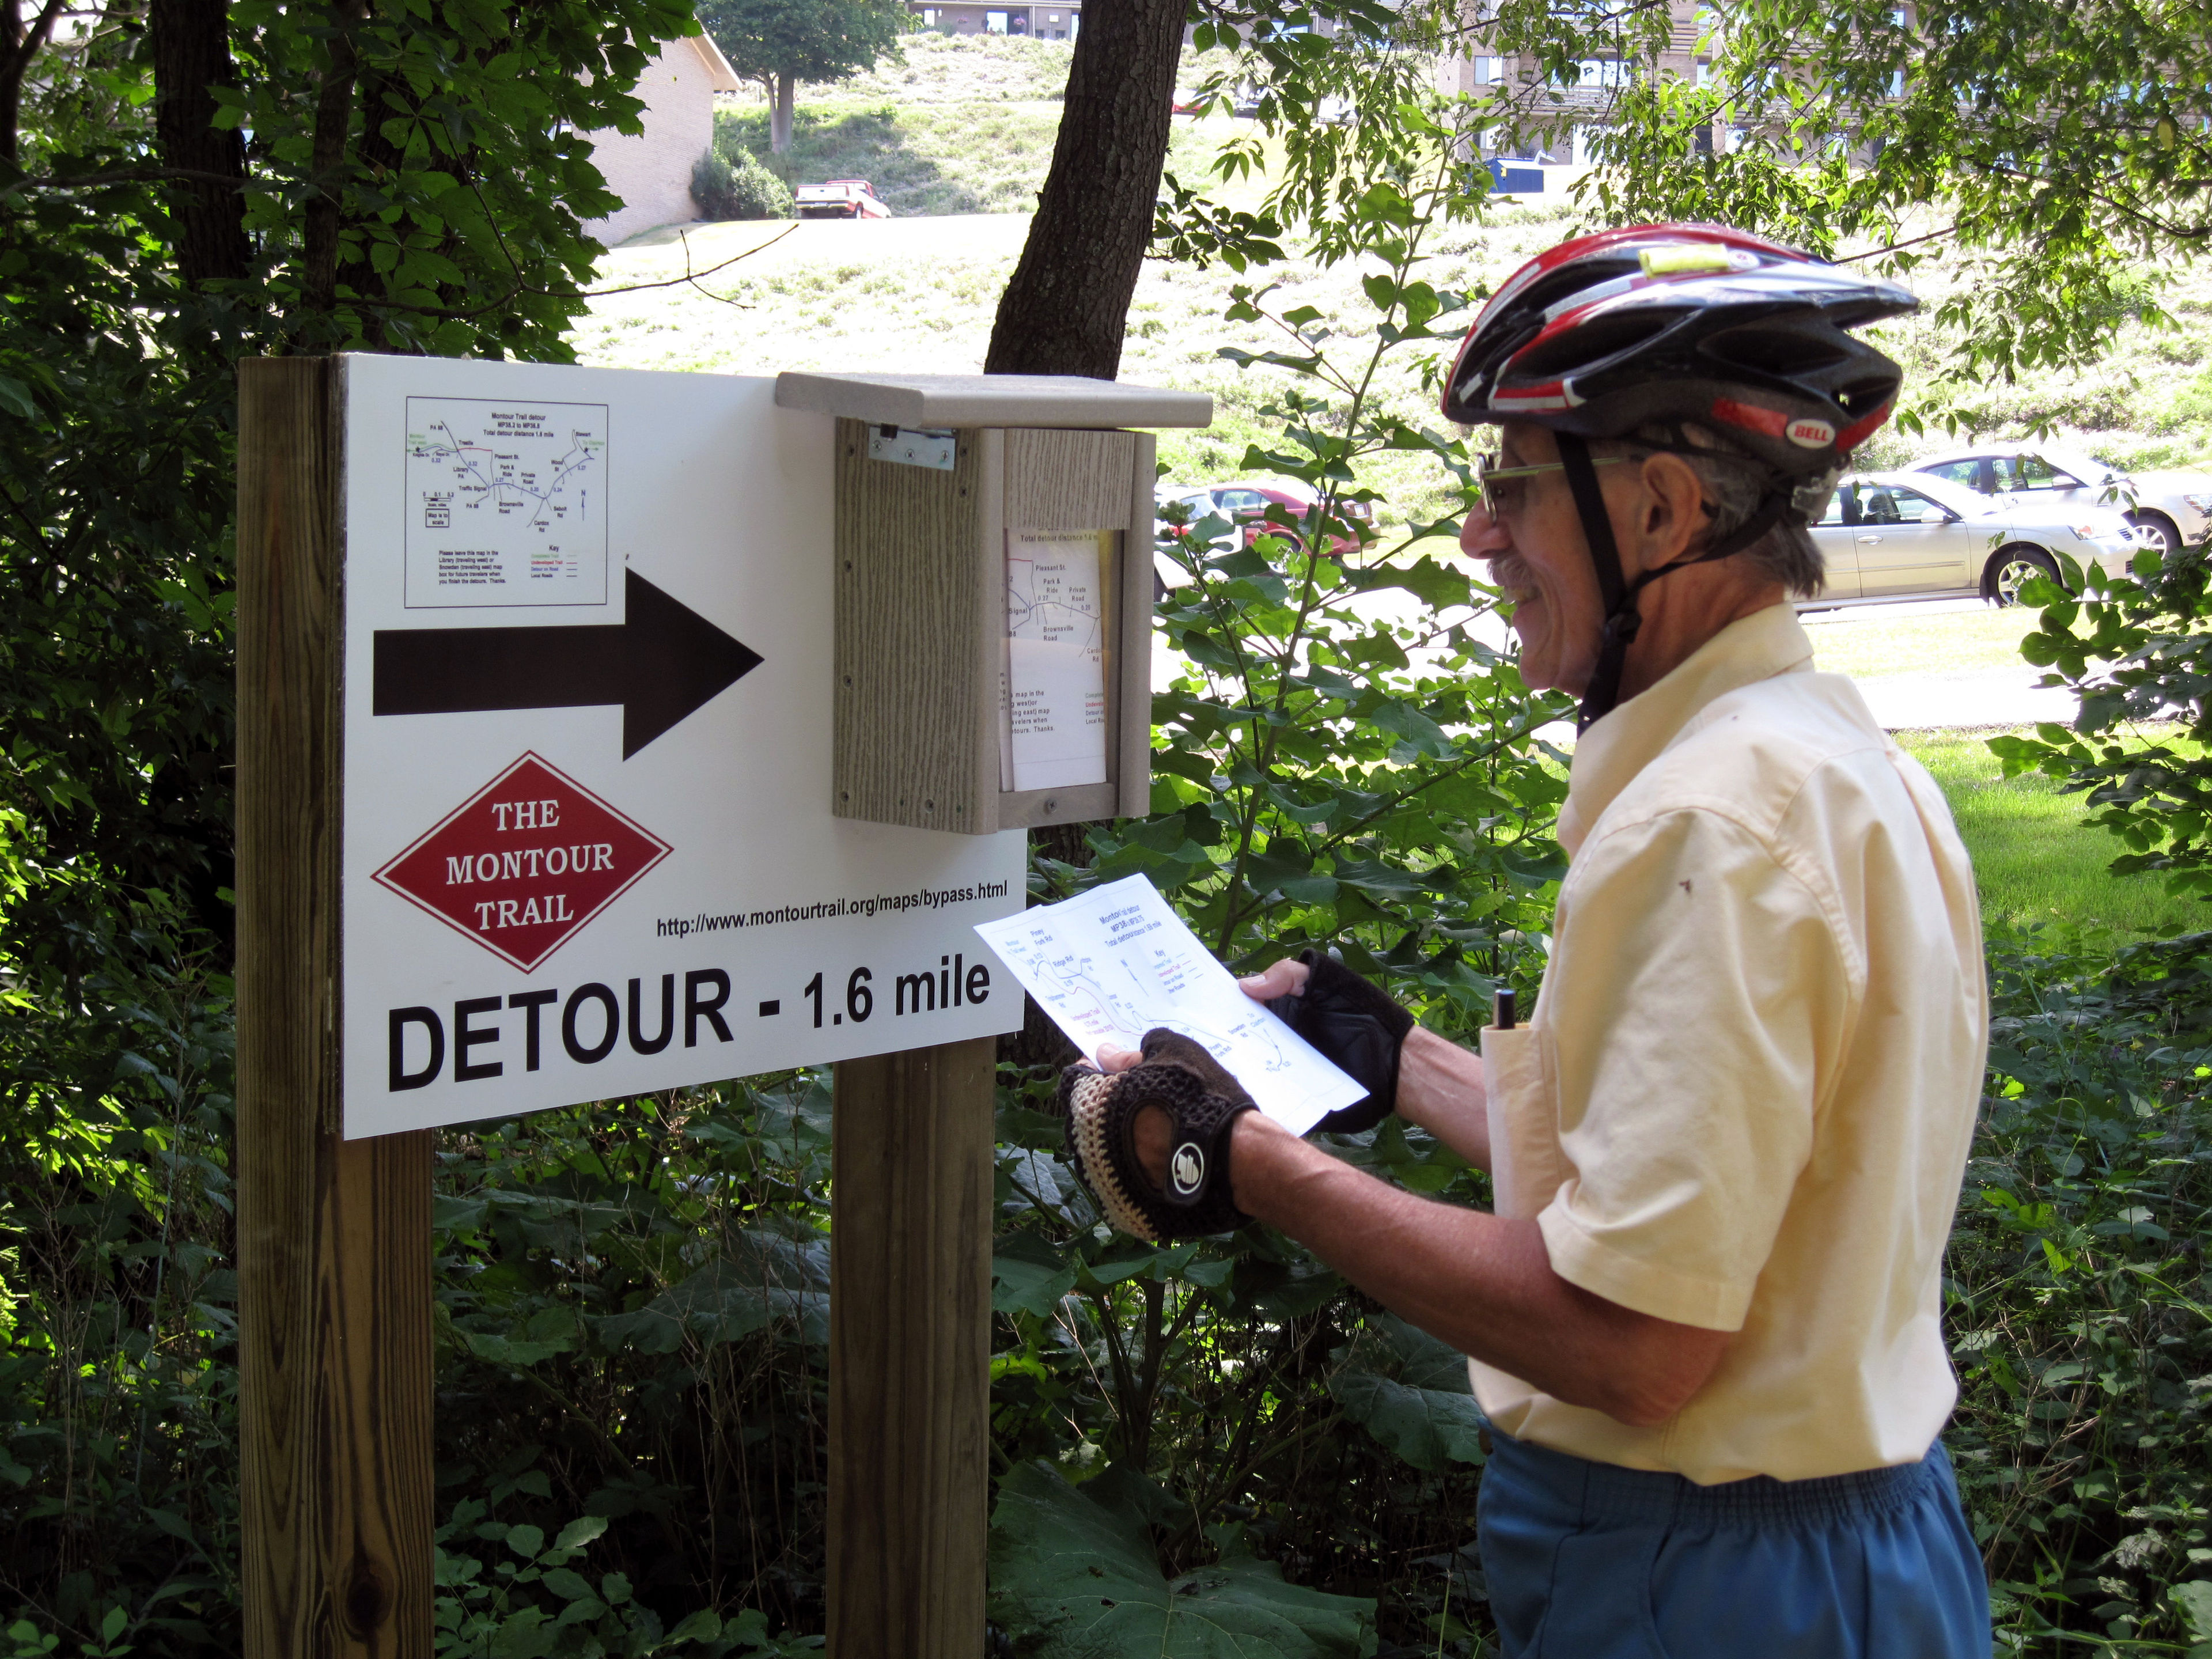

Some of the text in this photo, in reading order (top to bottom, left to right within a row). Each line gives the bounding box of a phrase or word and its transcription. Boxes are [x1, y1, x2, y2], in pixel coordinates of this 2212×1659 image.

[1794, 425, 1828, 442] BELL
[493, 799, 560, 832] THE
[446, 843, 615, 885] MONTOUR
[475, 894, 574, 931] TRAIL
[657, 879, 1008, 938] http://www.montourtrail.org/maps/bypass.html
[1105, 938, 1118, 948] Total
[1118, 931, 1134, 944] detou
[388, 954, 990, 1093] DETOUR - 1.6 mile
